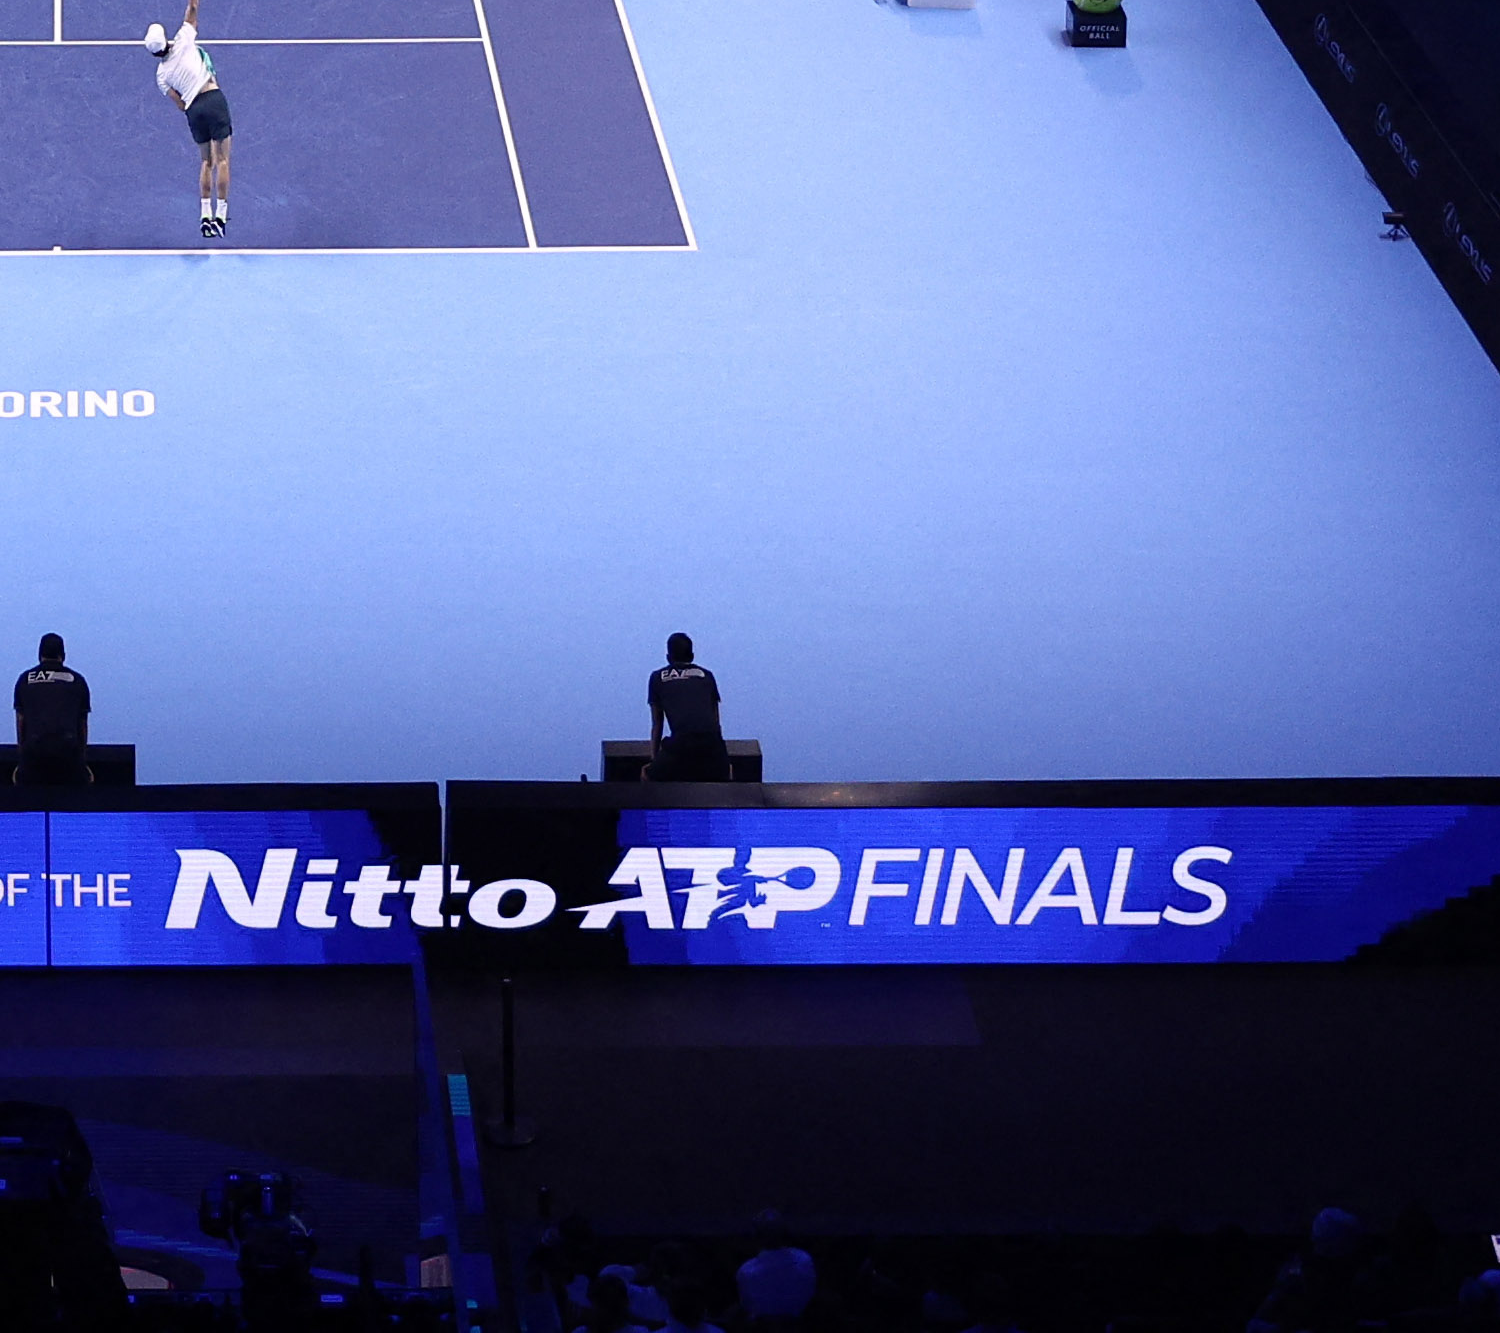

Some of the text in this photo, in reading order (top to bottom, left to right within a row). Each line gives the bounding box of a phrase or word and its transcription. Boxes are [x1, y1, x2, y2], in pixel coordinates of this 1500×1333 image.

[41, 872, 133, 907] THE
[164, 844, 1235, 931] Nitto ATP FINALS
